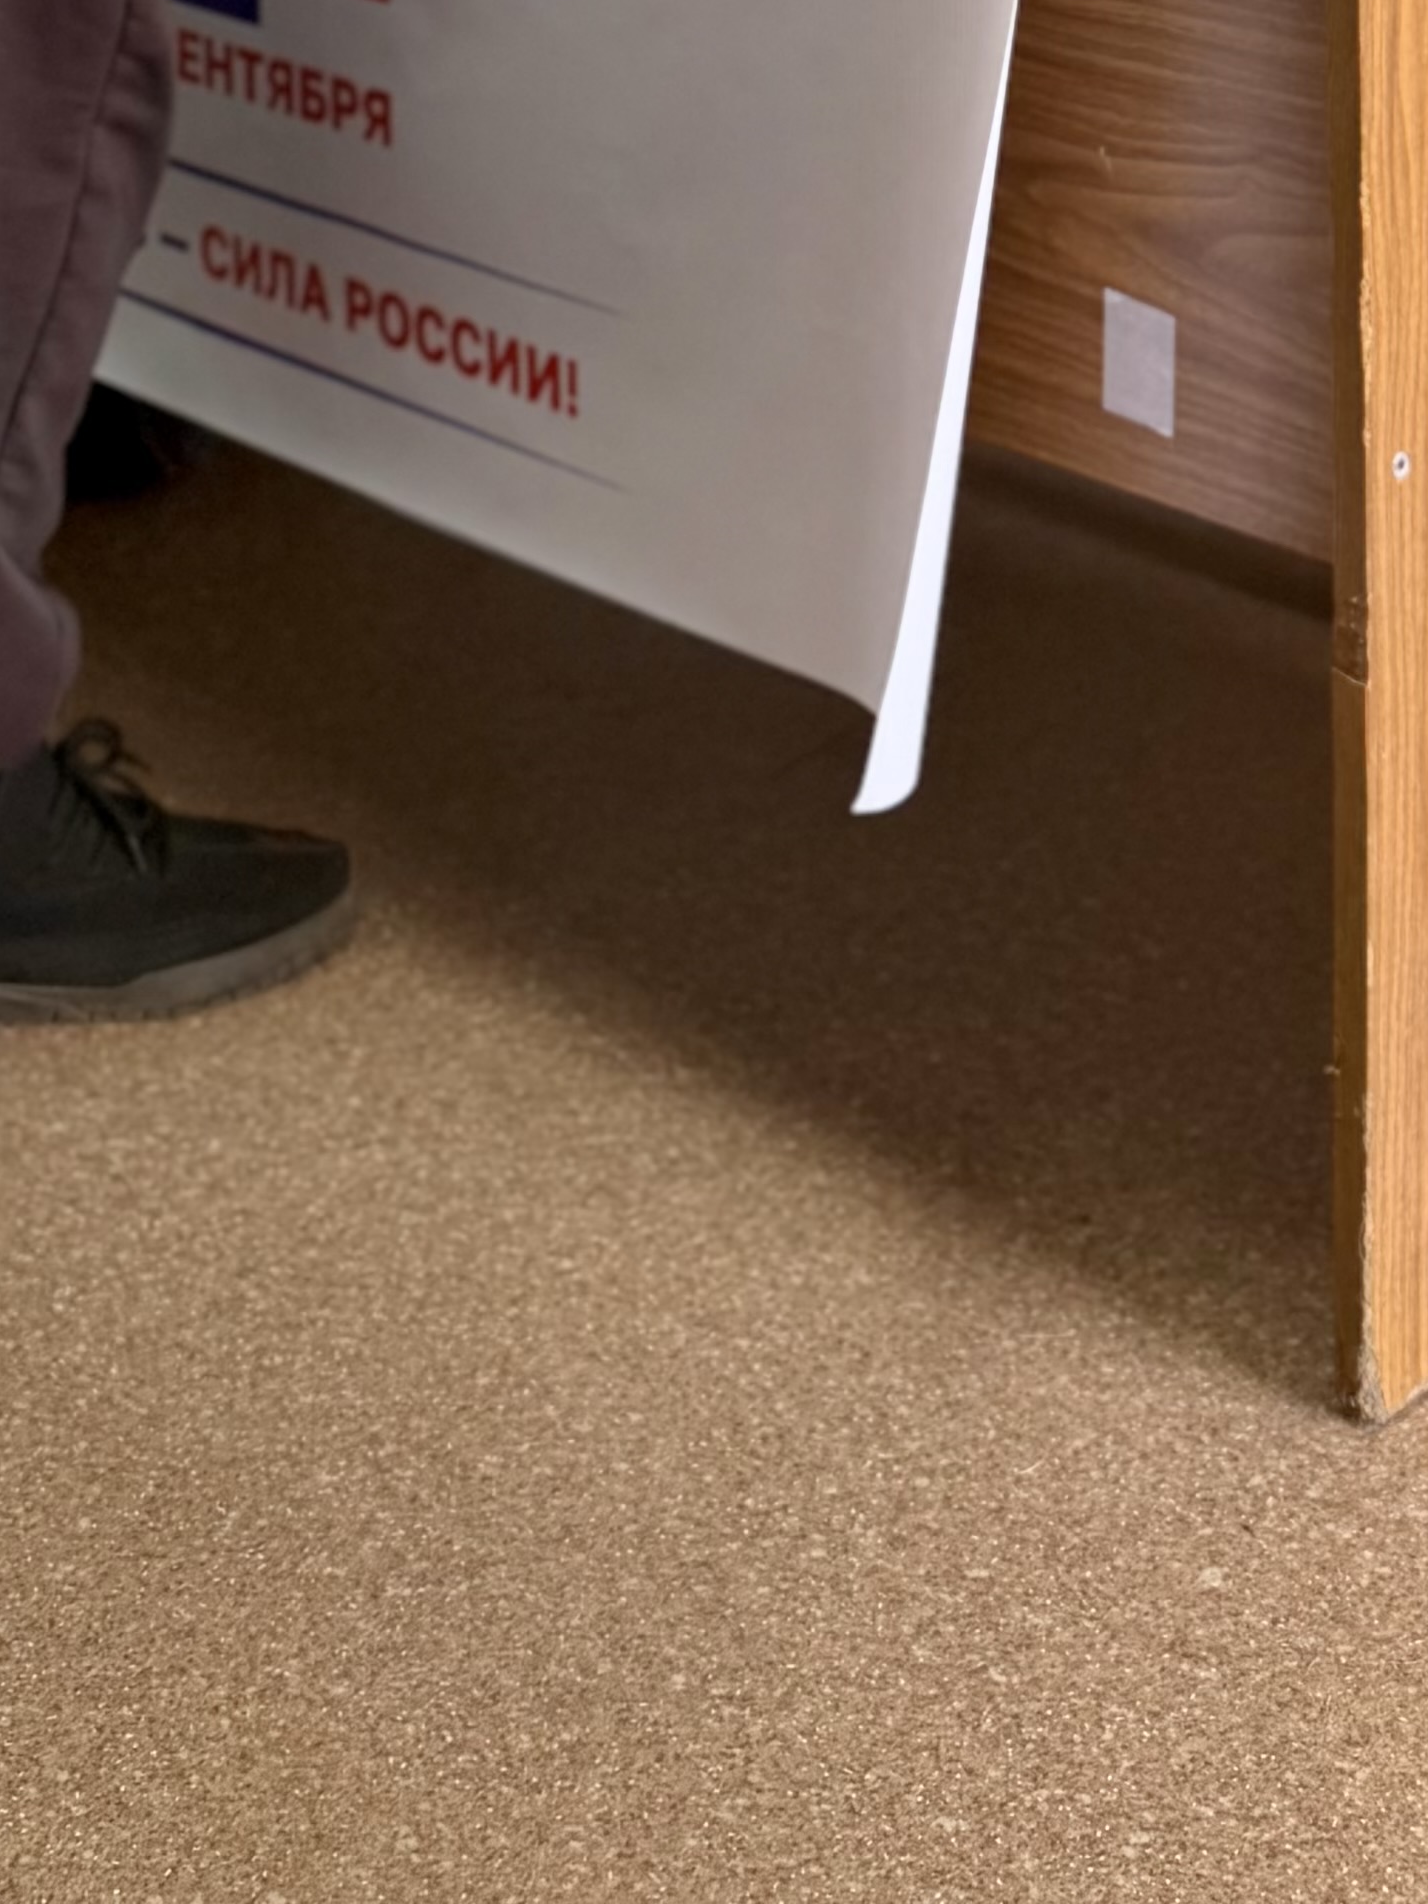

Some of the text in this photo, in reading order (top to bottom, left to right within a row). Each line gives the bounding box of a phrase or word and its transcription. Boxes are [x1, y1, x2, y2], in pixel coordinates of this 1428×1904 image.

[175, 28, 394, 148] ЕНТЯБРЯ
[200, 225, 331, 324] СИЛА
[344, 276, 579, 419] РОССИИ!
